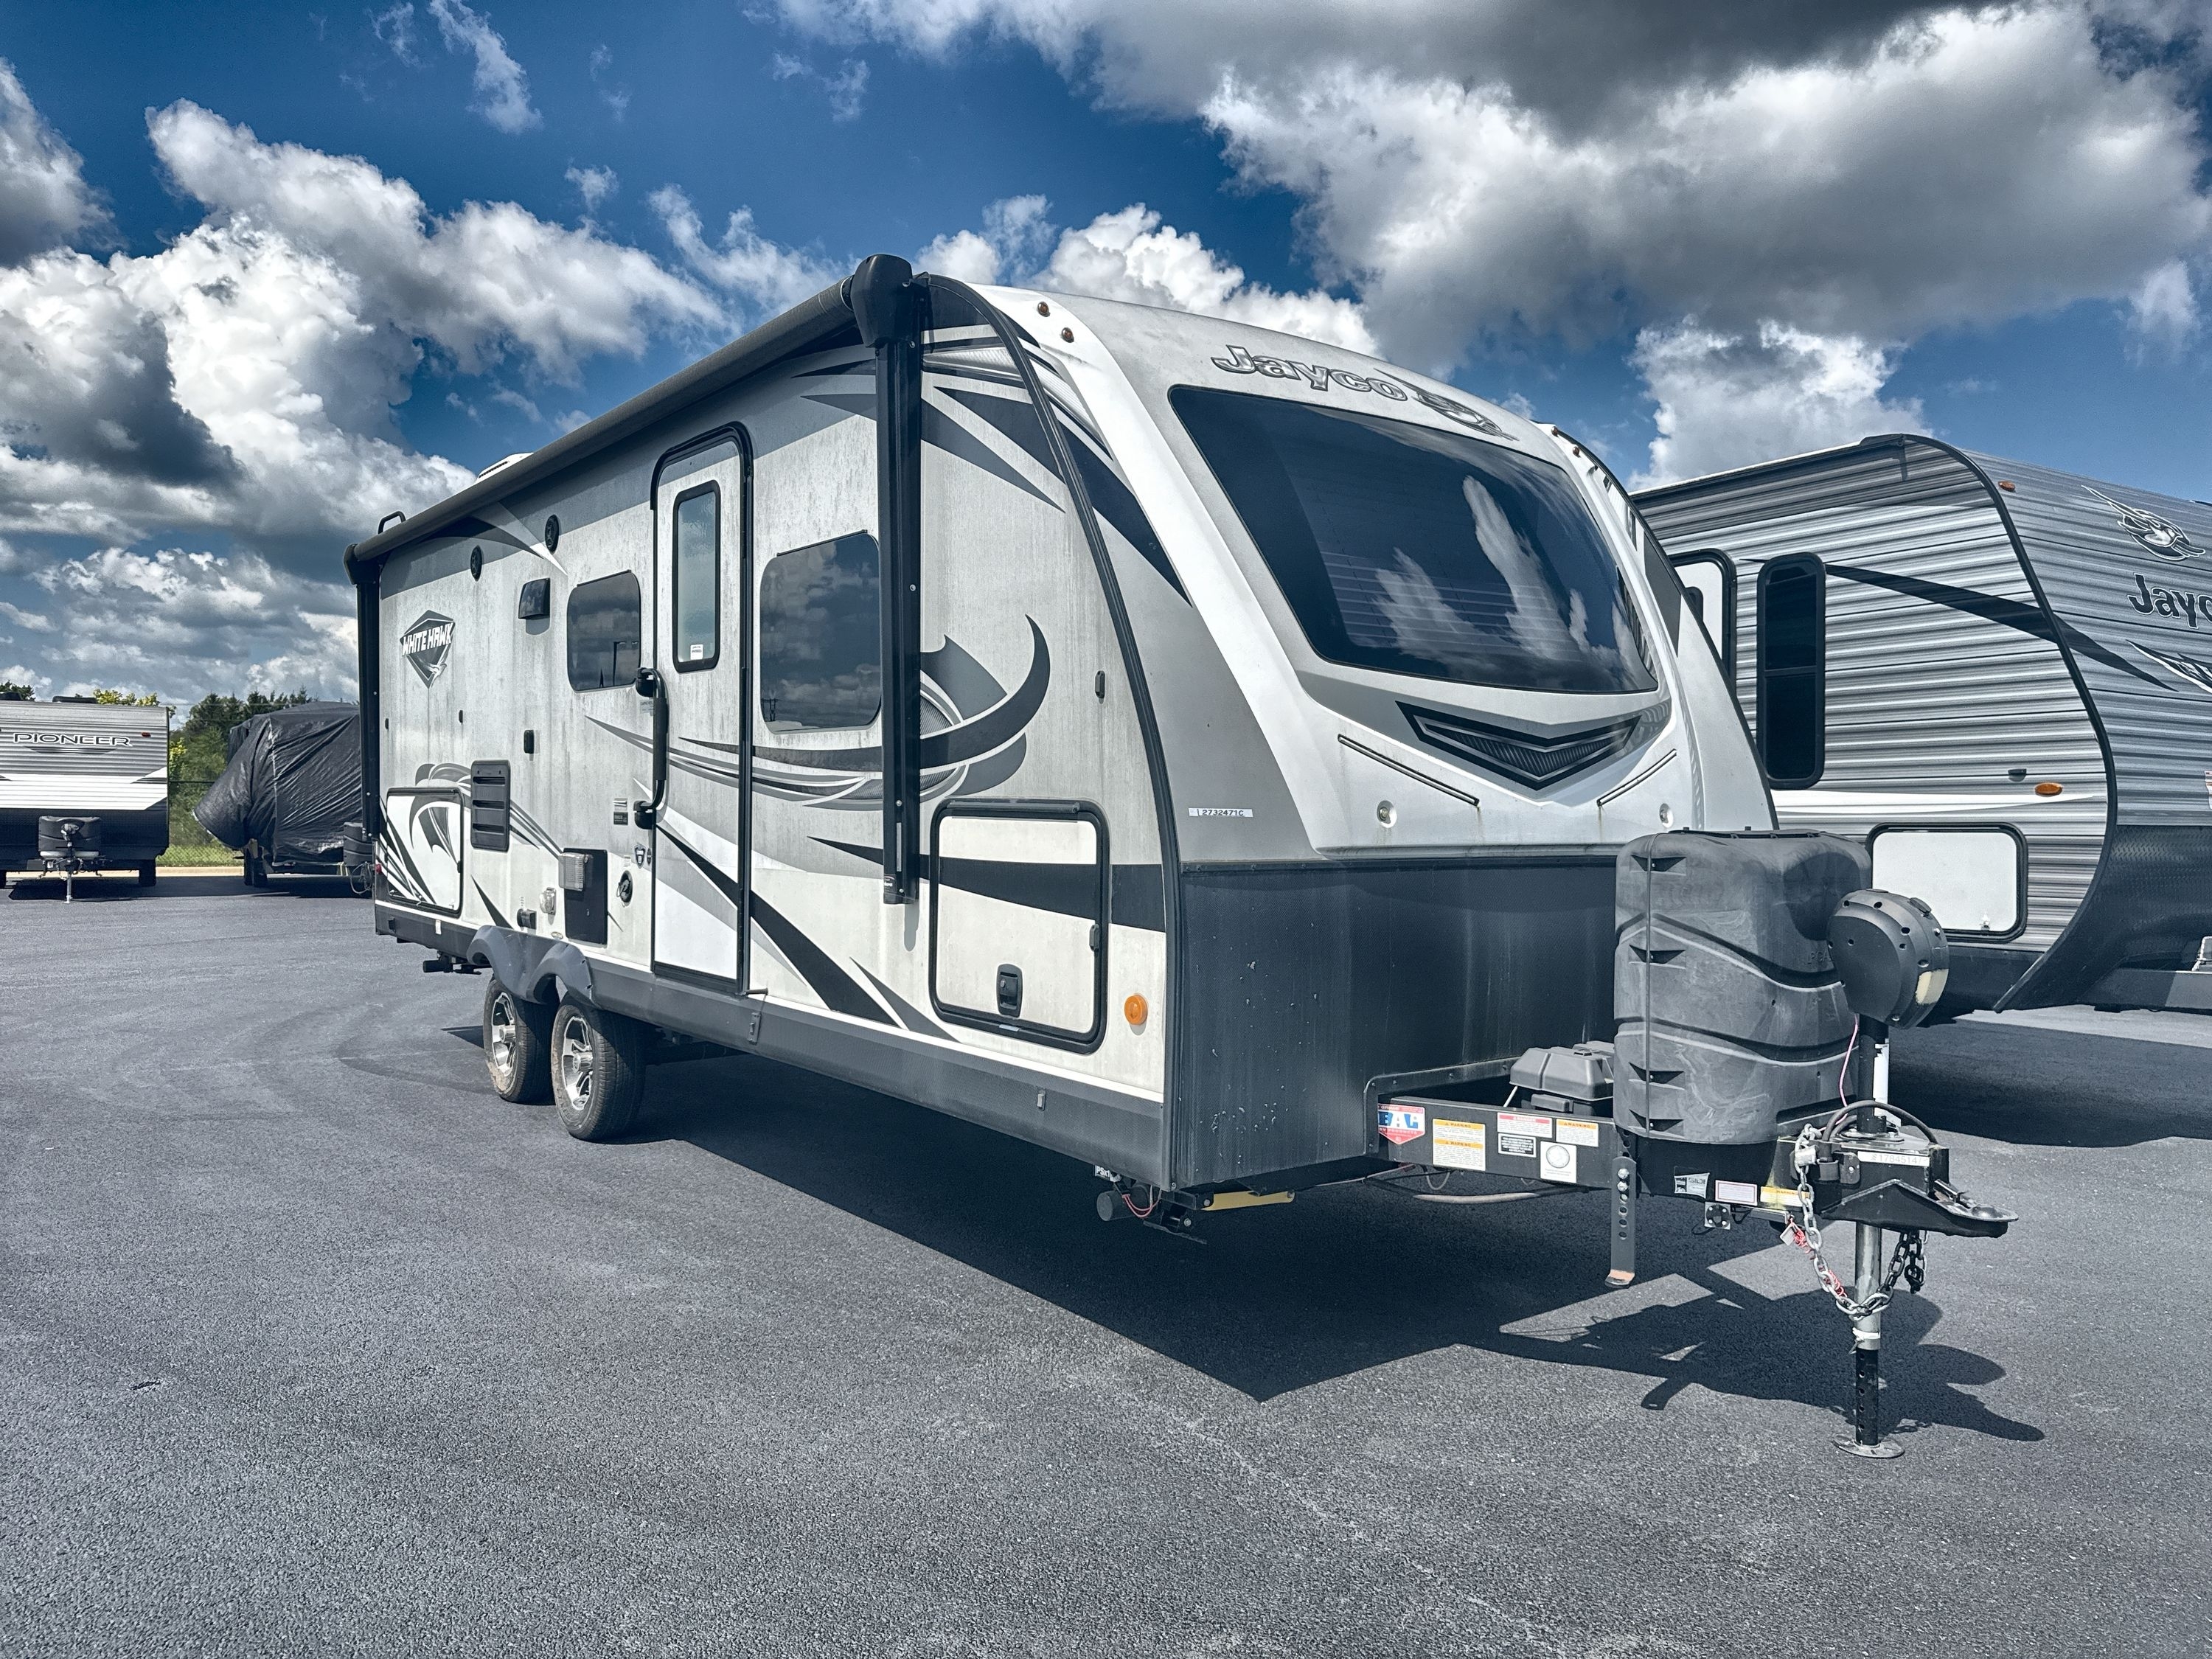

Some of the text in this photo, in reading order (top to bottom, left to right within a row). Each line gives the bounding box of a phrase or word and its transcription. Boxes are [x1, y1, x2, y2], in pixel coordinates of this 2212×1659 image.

[1211, 344, 1408, 401] Jayco
[402, 622, 453, 655] WHITE HAWK
[14, 733, 133, 746] PIONEER
